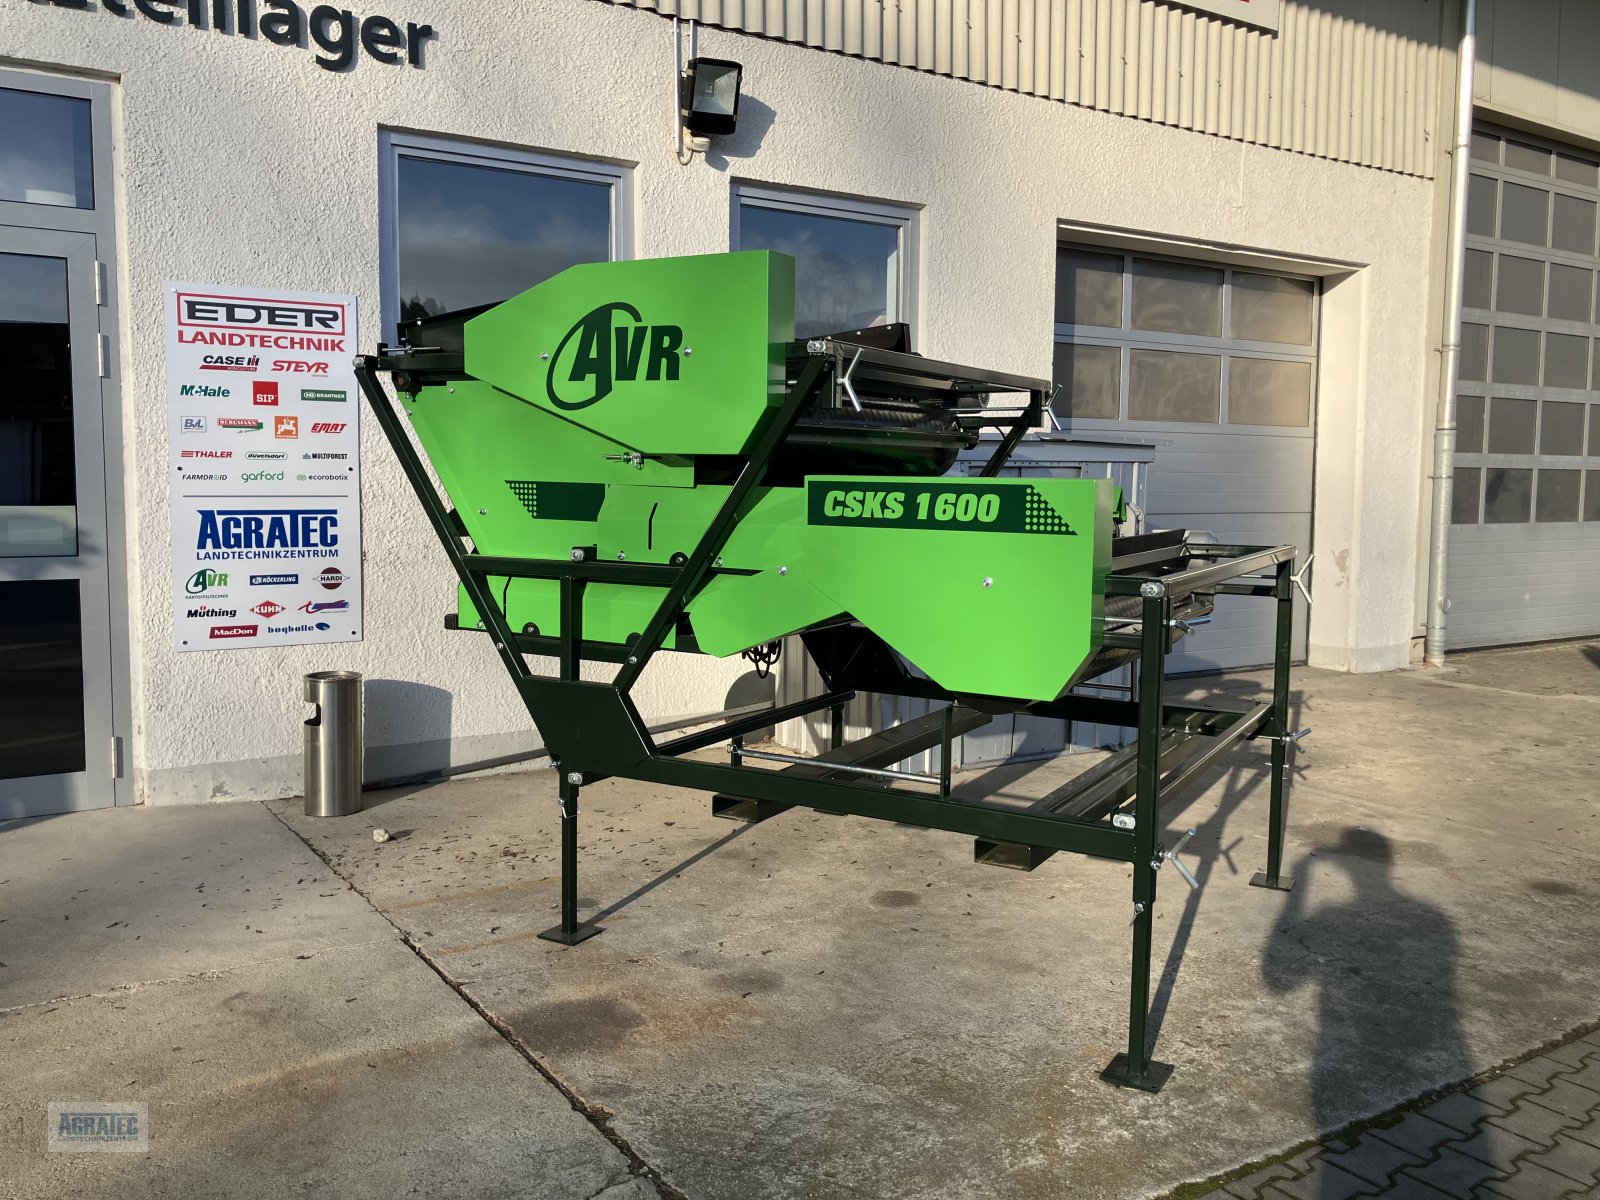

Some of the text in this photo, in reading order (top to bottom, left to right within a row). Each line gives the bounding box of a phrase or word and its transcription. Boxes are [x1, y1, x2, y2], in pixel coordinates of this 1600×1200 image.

[184, 300, 339, 329] EDER
[177, 329, 346, 353] LANDTECHNIK
[202, 354, 245, 366] CASE
[546, 301, 683, 411] AVR
[270, 359, 330, 374] STEYR
[179, 384, 231, 398] McHale
[256, 393, 275, 403] SIP
[194, 450, 233, 458] THALER
[241, 470, 284, 483] garford
[823, 490, 1001, 523] CSKS 1600
[195, 509, 338, 549] AGRATEC
[196, 549, 339, 561] LANDTECHNIKZENTRUM
[185, 568, 229, 594] AVR
[186, 605, 237, 618] Müthing
[254, 605, 282, 614] KUHN
